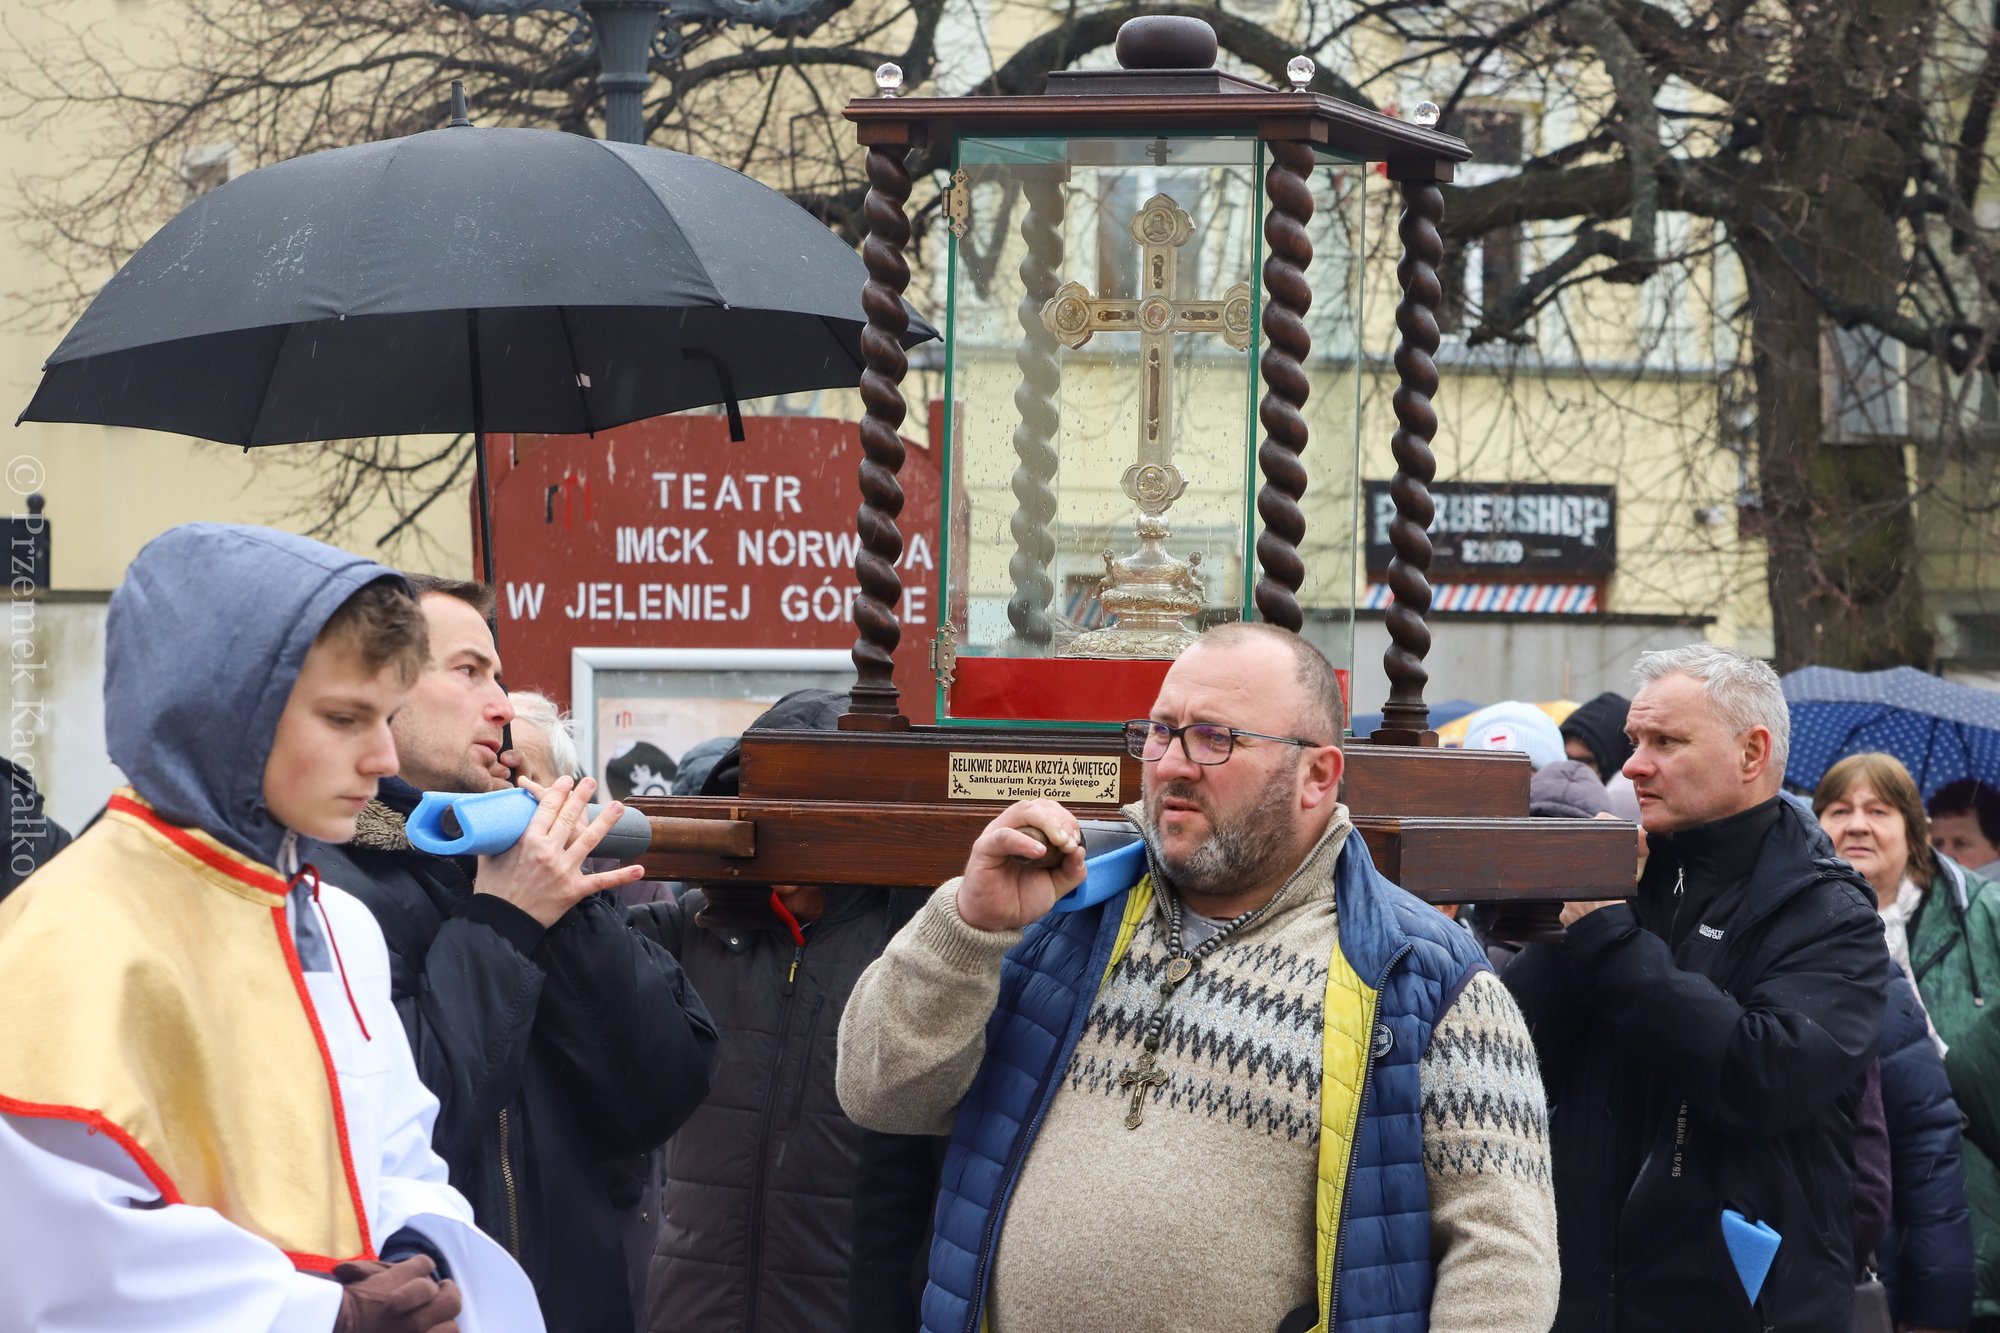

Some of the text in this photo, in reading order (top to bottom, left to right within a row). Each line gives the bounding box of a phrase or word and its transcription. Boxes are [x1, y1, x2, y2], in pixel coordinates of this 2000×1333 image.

[652, 472, 802, 513] TEATR
[1373, 492, 1610, 546] BRBERSHOP
[738, 528, 934, 570] NORWA
[506, 576, 927, 624] W JELENIEJ GÓE
[952, 757, 1118, 778] RELIKWIE DRZEWA KRZYŻA ŚWIĘTEGO
[969, 774, 1100, 788] Sanktuarium Krzyża Świętego
[997, 787, 1071, 799] w Jeleniej Górze
